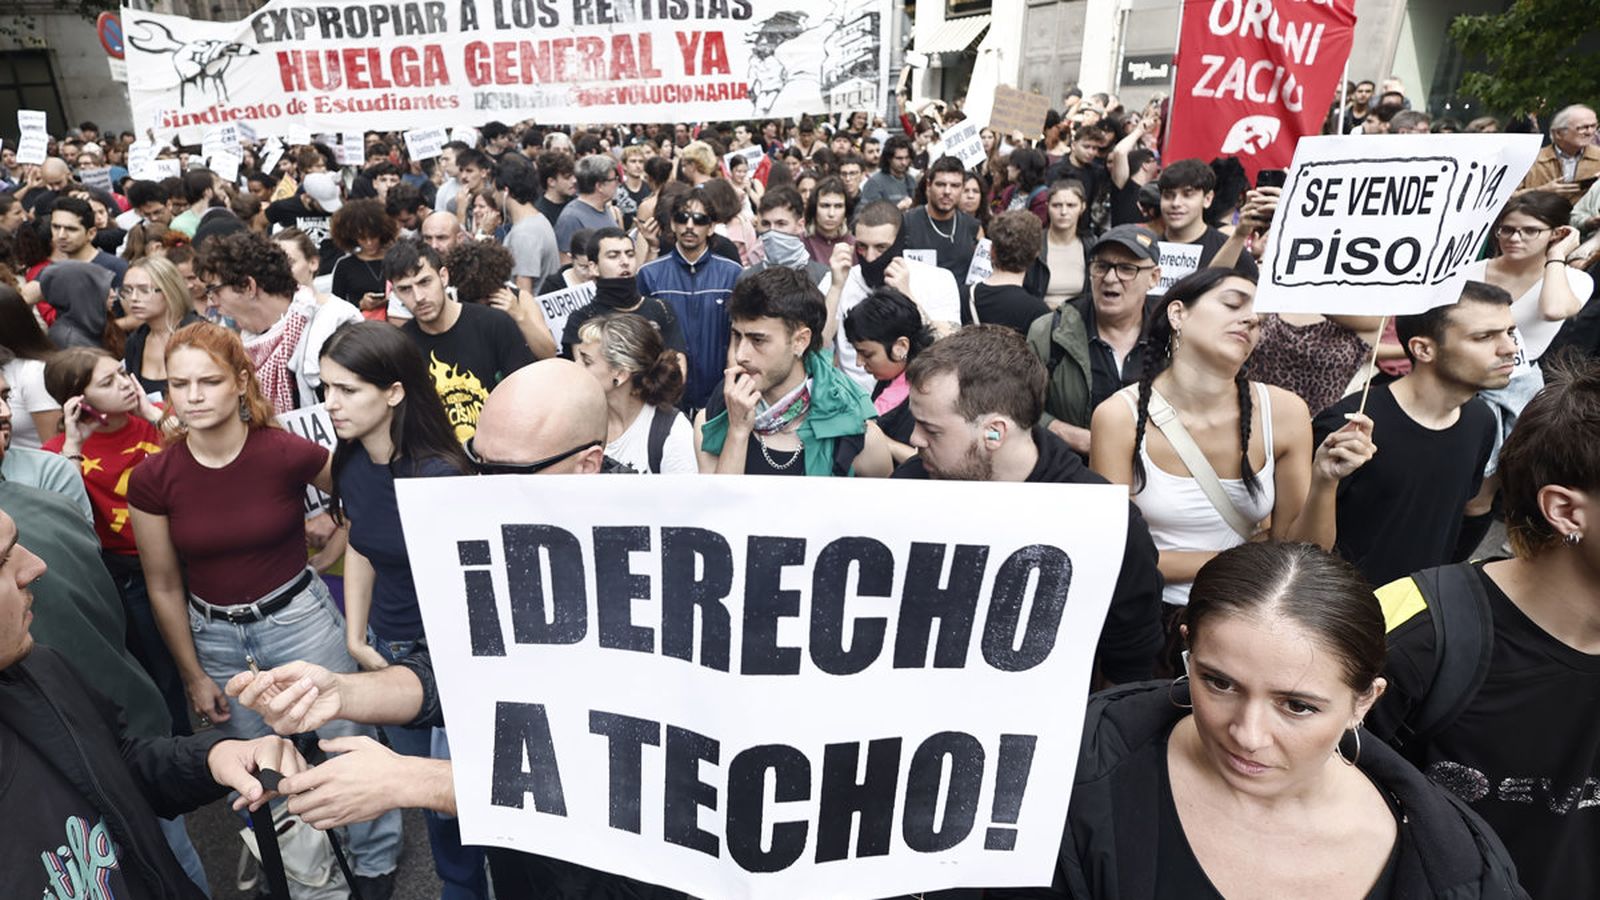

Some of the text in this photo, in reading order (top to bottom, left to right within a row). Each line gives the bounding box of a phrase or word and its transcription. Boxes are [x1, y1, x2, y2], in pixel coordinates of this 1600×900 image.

[251, 1, 448, 44] EXPROPIAR
[459, 0, 479, 32] A
[493, 0, 560, 30] LOS
[276, 31, 732, 92] HUELGA GENERAL YA
[286, 98, 308, 115] de
[314, 92, 460, 114] Estudiantes
[1301, 175, 1439, 217] SE VENDE
[1159, 251, 1198, 269] erechos
[456, 523, 1073, 676] ¡DERECHO
[490, 701, 1039, 874] A TECHO!
